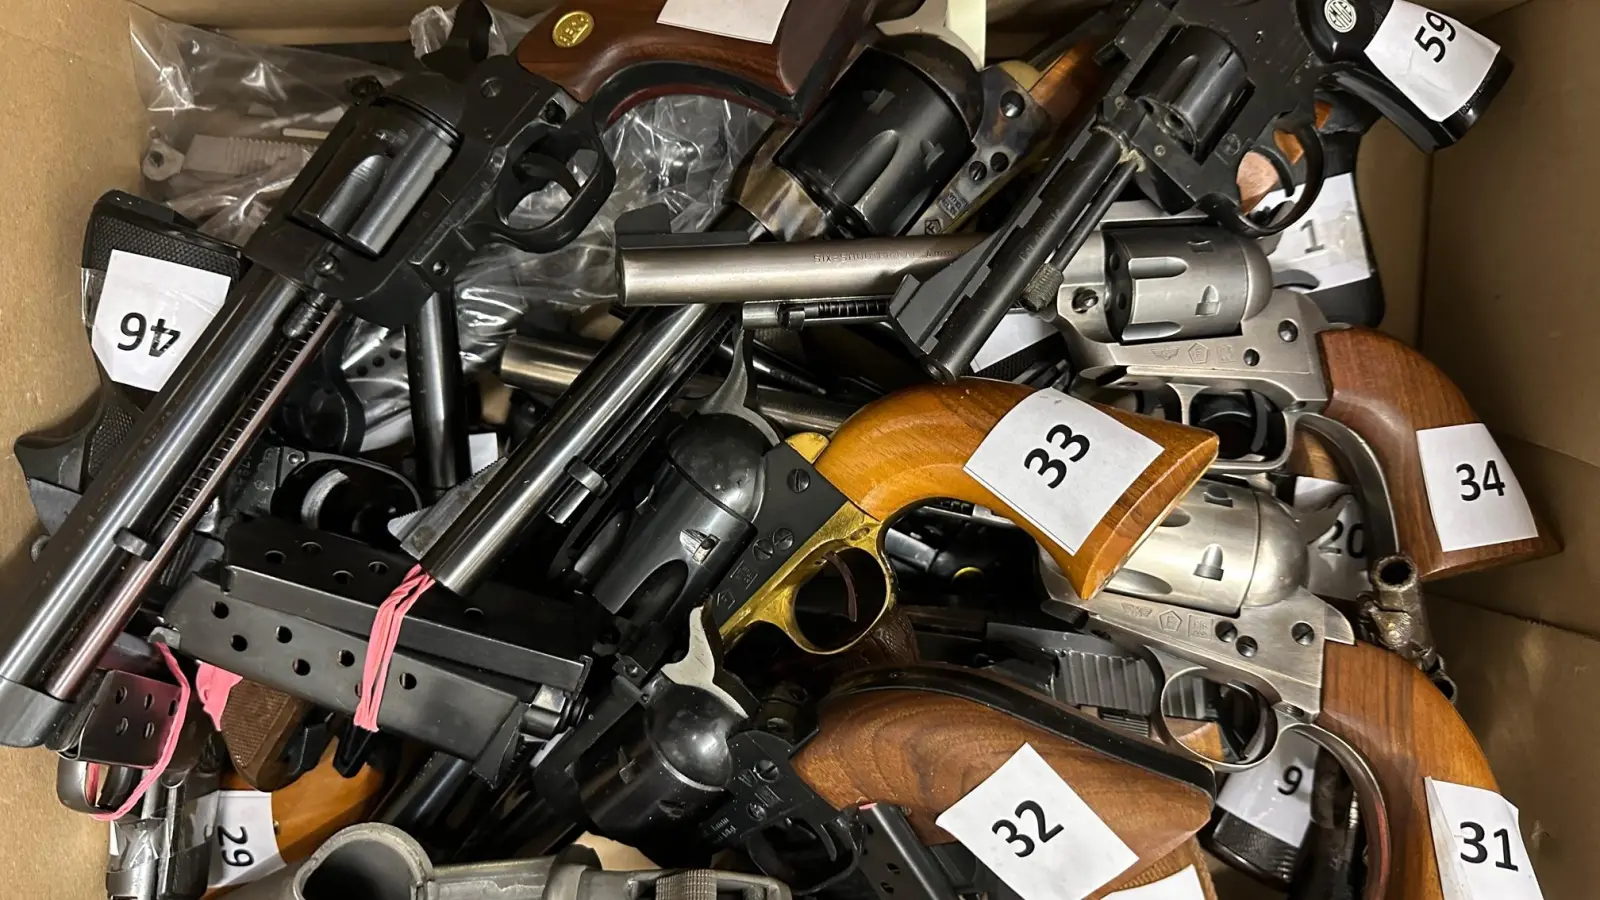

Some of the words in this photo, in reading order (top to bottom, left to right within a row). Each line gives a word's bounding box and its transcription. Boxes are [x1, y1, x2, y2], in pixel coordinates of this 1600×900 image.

[1414, 11, 1456, 63] 59
[1300, 219, 1325, 254] 1
[117, 311, 181, 358] 46
[1023, 423, 1091, 489] 33
[1455, 460, 1505, 501] 34
[1318, 519, 1366, 558] 20
[1277, 765, 1303, 795] 9
[217, 825, 255, 867] 29
[991, 799, 1064, 858] 32
[1460, 821, 1519, 872] 31
